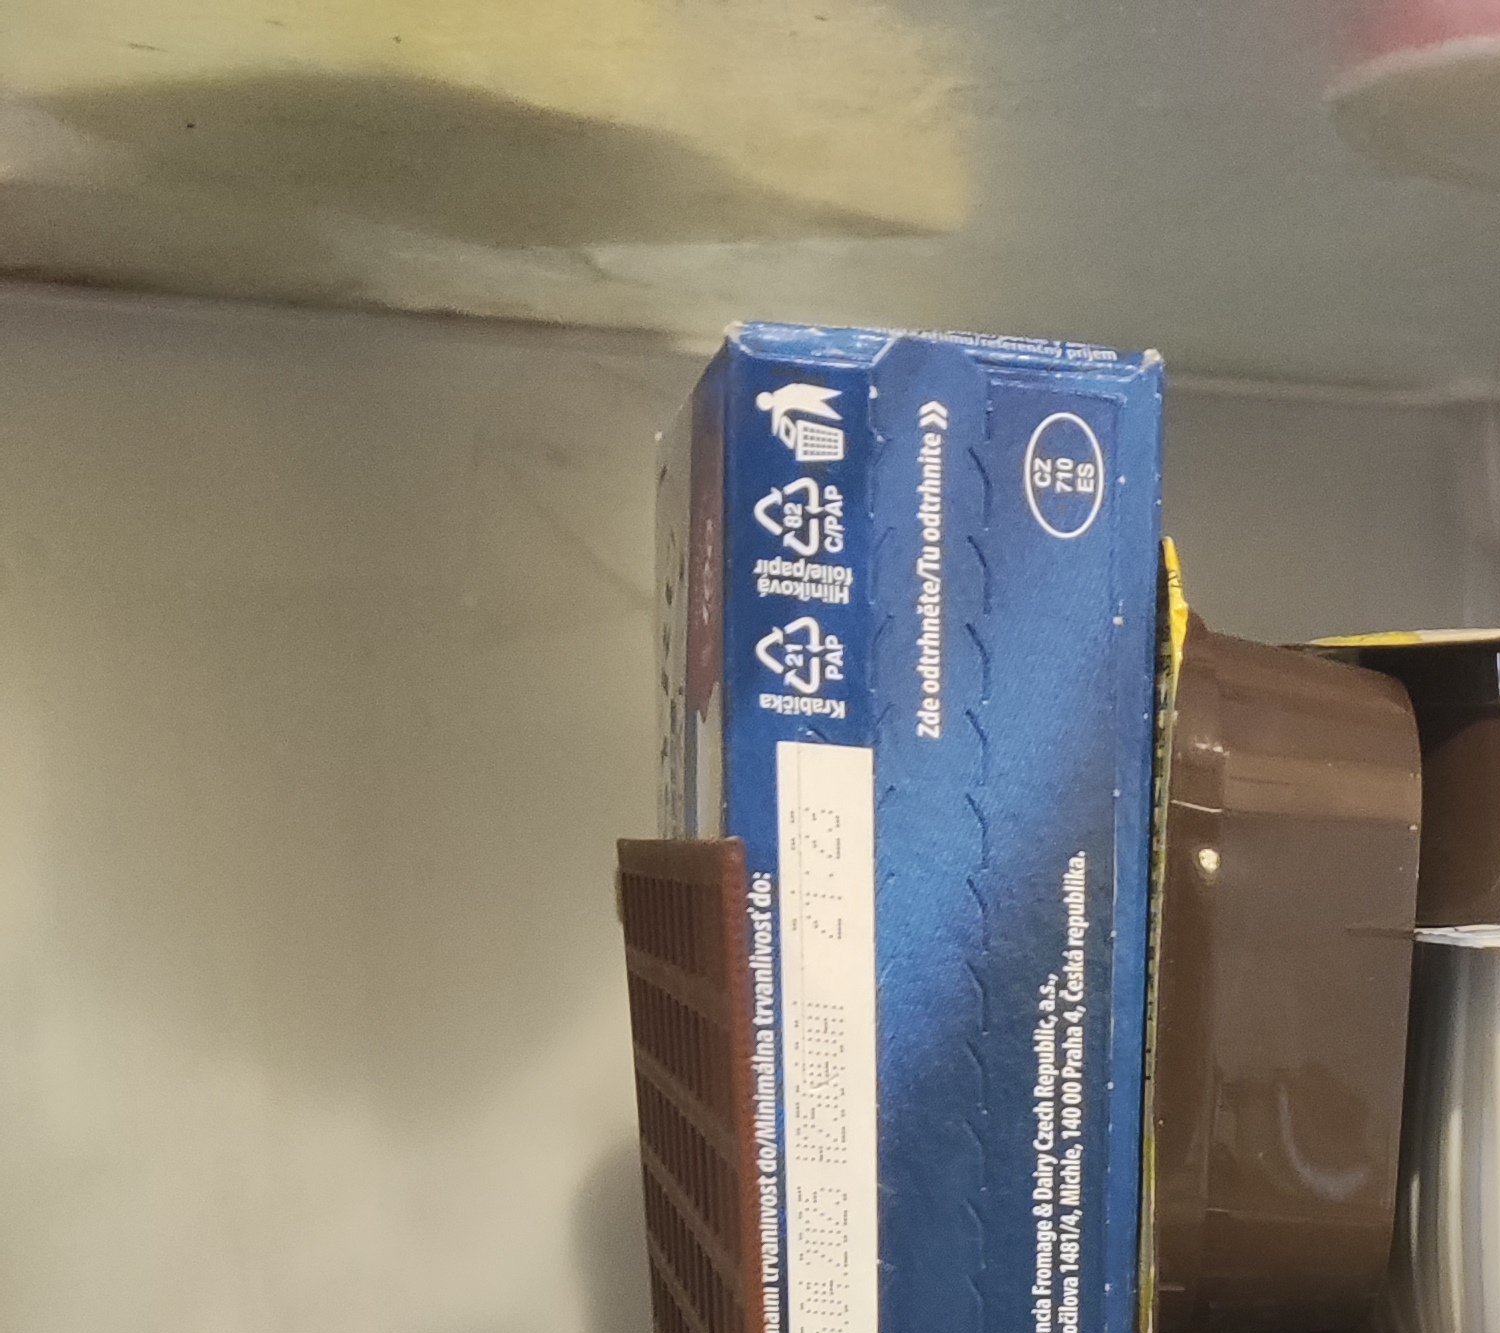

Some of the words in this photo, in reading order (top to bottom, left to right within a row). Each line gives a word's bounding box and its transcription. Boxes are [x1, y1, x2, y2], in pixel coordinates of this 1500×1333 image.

[916, 432, 942, 542] odtrhnite
[1032, 457, 1052, 488] CZ
[1055, 457, 1074, 494] 710
[1076, 461, 1095, 493] ES
[783, 502, 803, 528] 82
[824, 484, 845, 553] C/PAP
[753, 556, 854, 585] fólie/papír
[756, 577, 850, 605] Hliníková
[916, 545, 941, 694] odtrhněte/Tu
[784, 643, 804, 667] 21
[824, 634, 845, 680] PAP
[758, 692, 846, 719] Krabička
[916, 703, 941, 739] Zde
[746, 871, 772, 908] do:
[1062, 849, 1091, 947] republika.
[746, 907, 775, 1027] trvanlivosť
[1058, 948, 1085, 1003] Česká
[1039, 972, 1059, 1012] a.s.,
[1063, 1005, 1088, 1024] 4,
[1033, 1014, 1060, 1098] Republic,
[1061, 1025, 1084, 1079] Praha
[750, 1028, 778, 1173] do/Minimálna
[1060, 1080, 1083, 1105] 00
[1032, 1099, 1056, 1151] Czech
[1060, 1105, 1083, 1140] 140
[1031, 1153, 1059, 1200] Dairy
[1058, 1143, 1085, 1206] Michle,
[758, 1173, 779, 1284] trvanlivost
[1032, 1203, 1054, 1217] &
[1031, 1218, 1058, 1296] Fromage
[1058, 1208, 1084, 1274] 1481/4,
